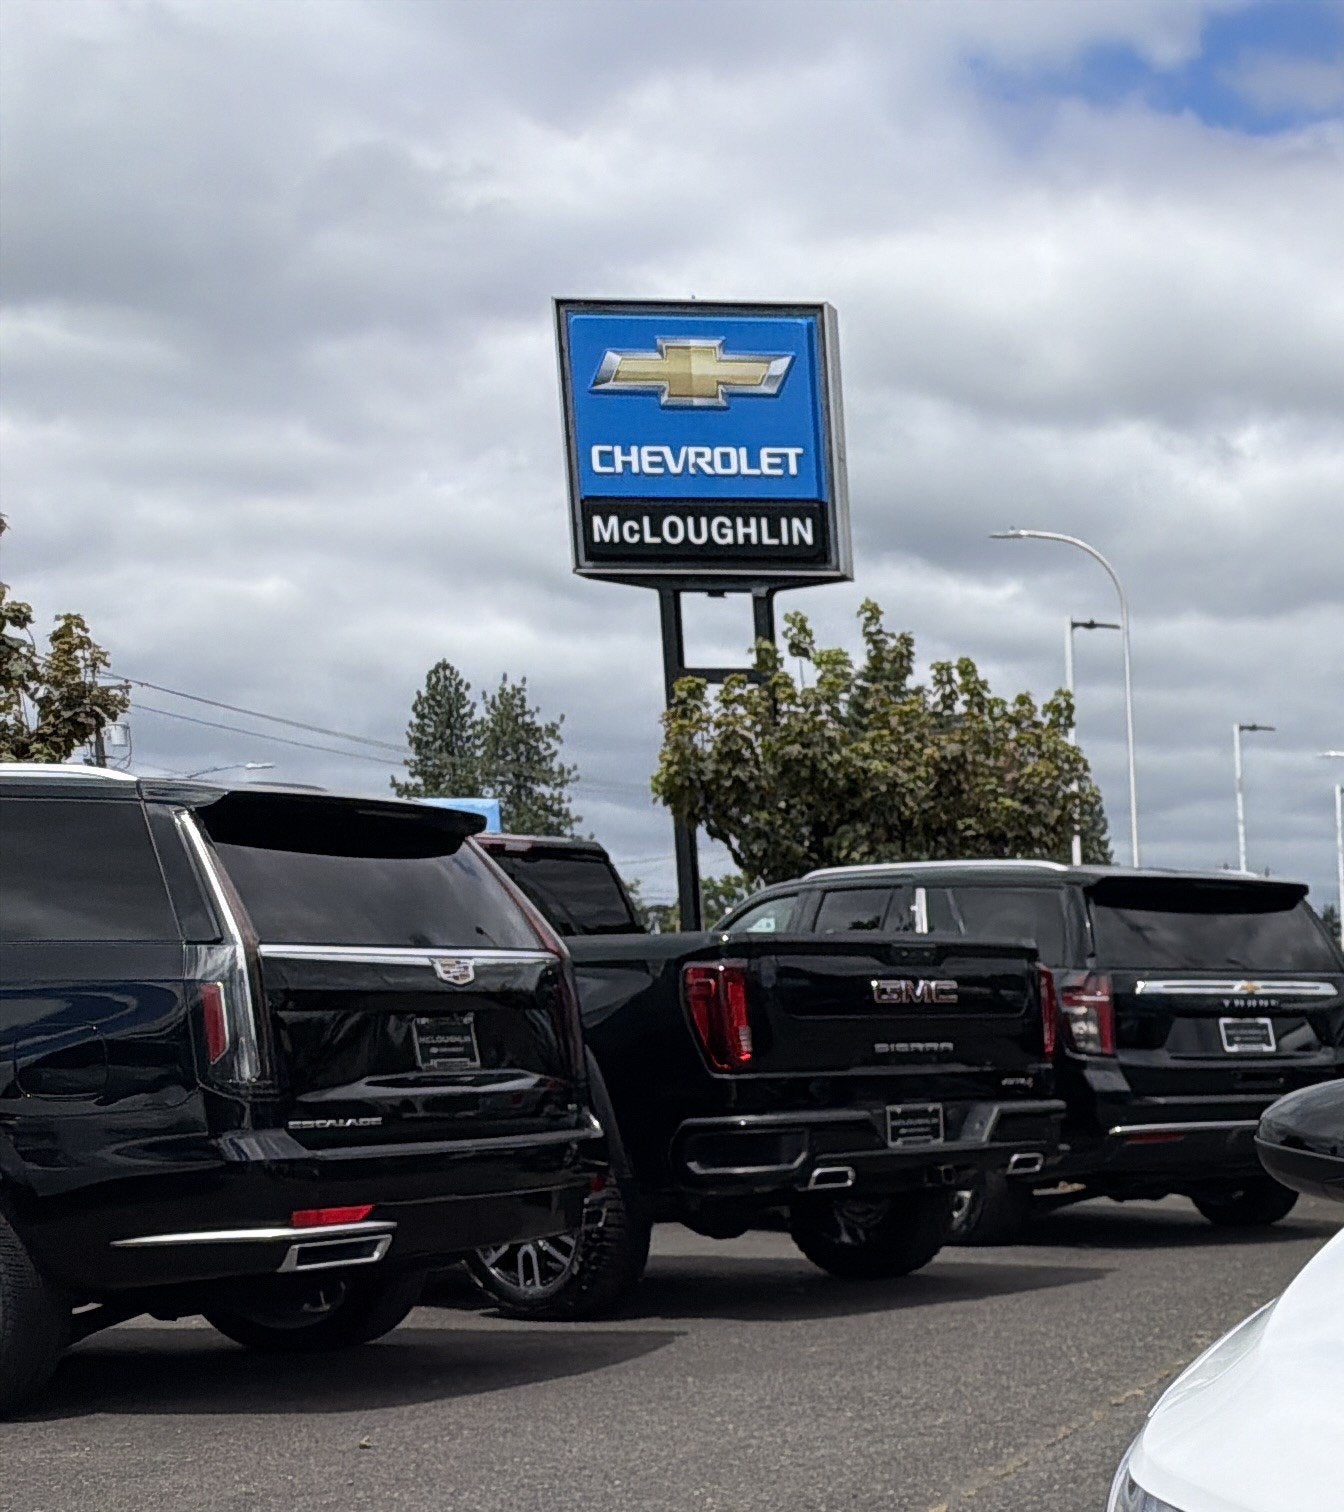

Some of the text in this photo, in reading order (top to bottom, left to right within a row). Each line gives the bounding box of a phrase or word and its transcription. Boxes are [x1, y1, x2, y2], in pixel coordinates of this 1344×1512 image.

[591, 445, 804, 476] CHEVROLET
[592, 515, 814, 546] McLOUGHLIN
[870, 979, 958, 1003] GMC
